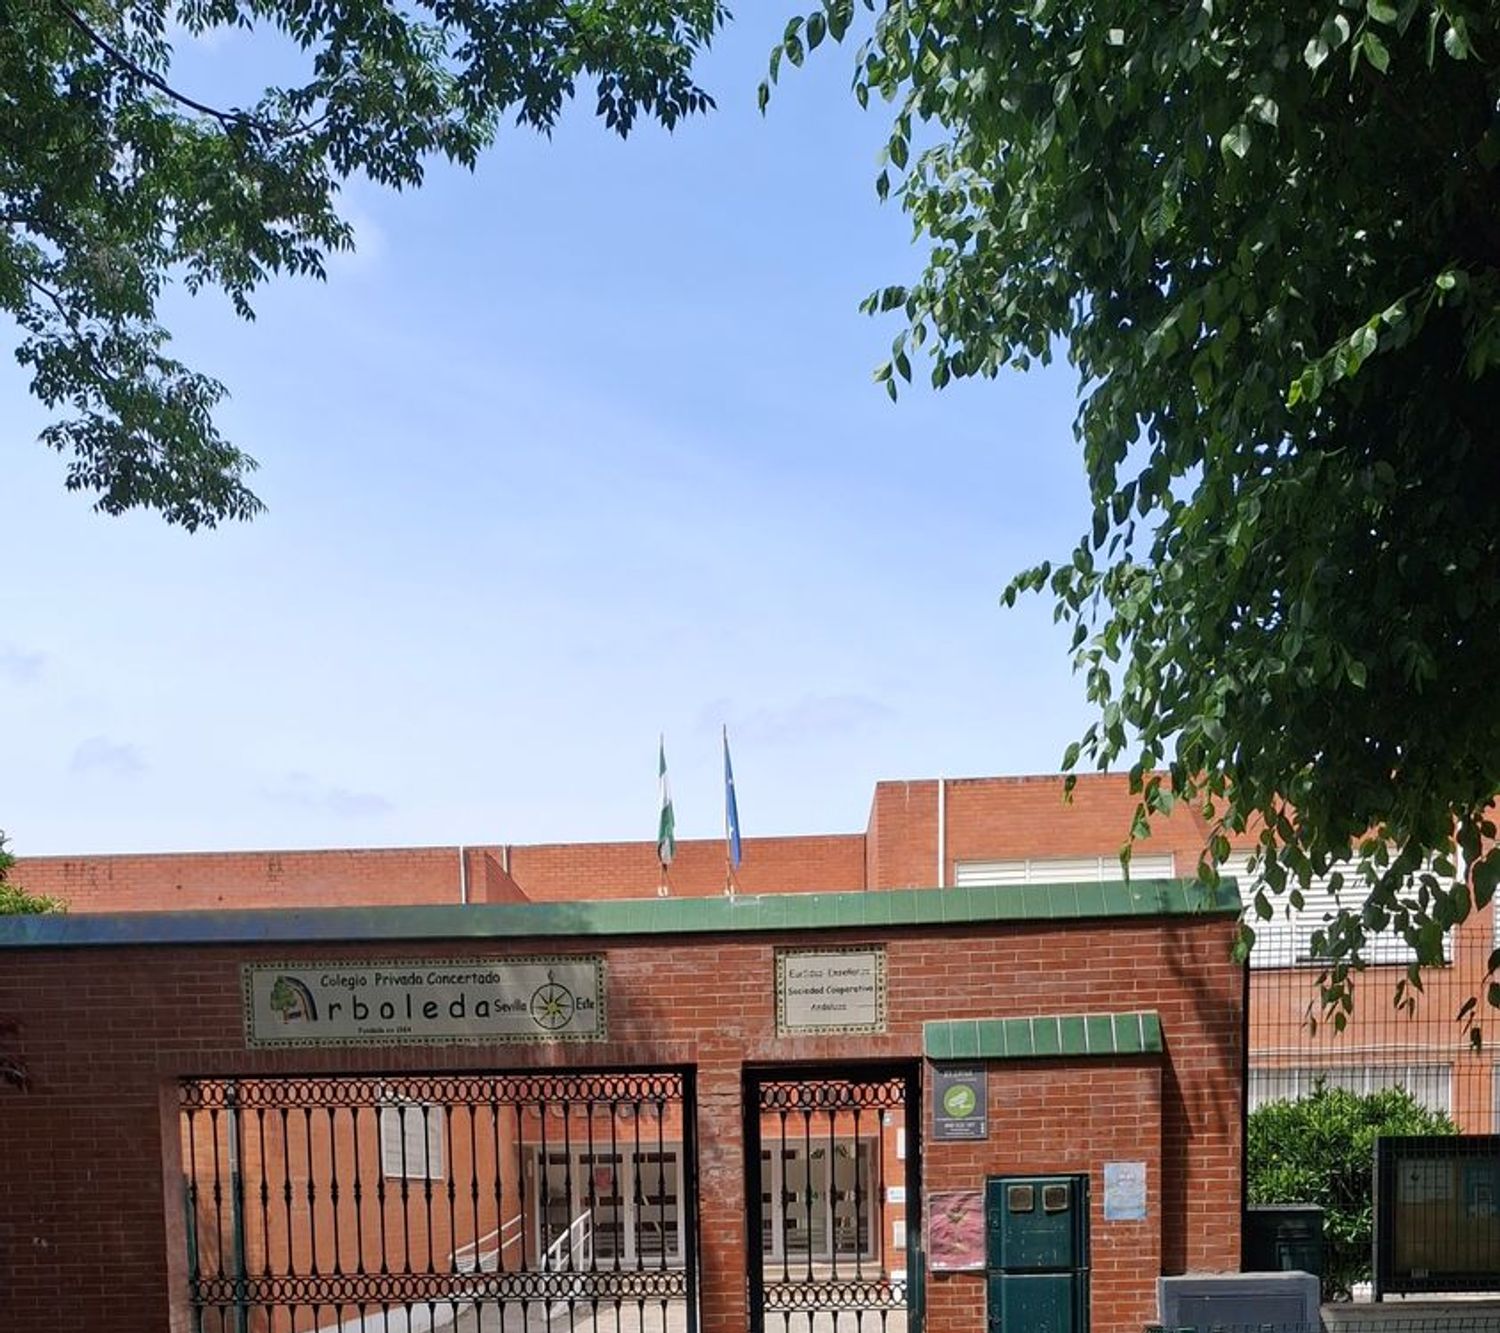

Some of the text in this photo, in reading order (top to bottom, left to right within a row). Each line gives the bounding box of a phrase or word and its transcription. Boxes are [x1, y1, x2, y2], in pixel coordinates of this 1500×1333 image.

[320, 974, 367, 991] Colegio
[427, 970, 501, 985] Concertado
[787, 983, 874, 996] Sociedad Cooperativa
[494, 997, 595, 1012] Sevilla Este
